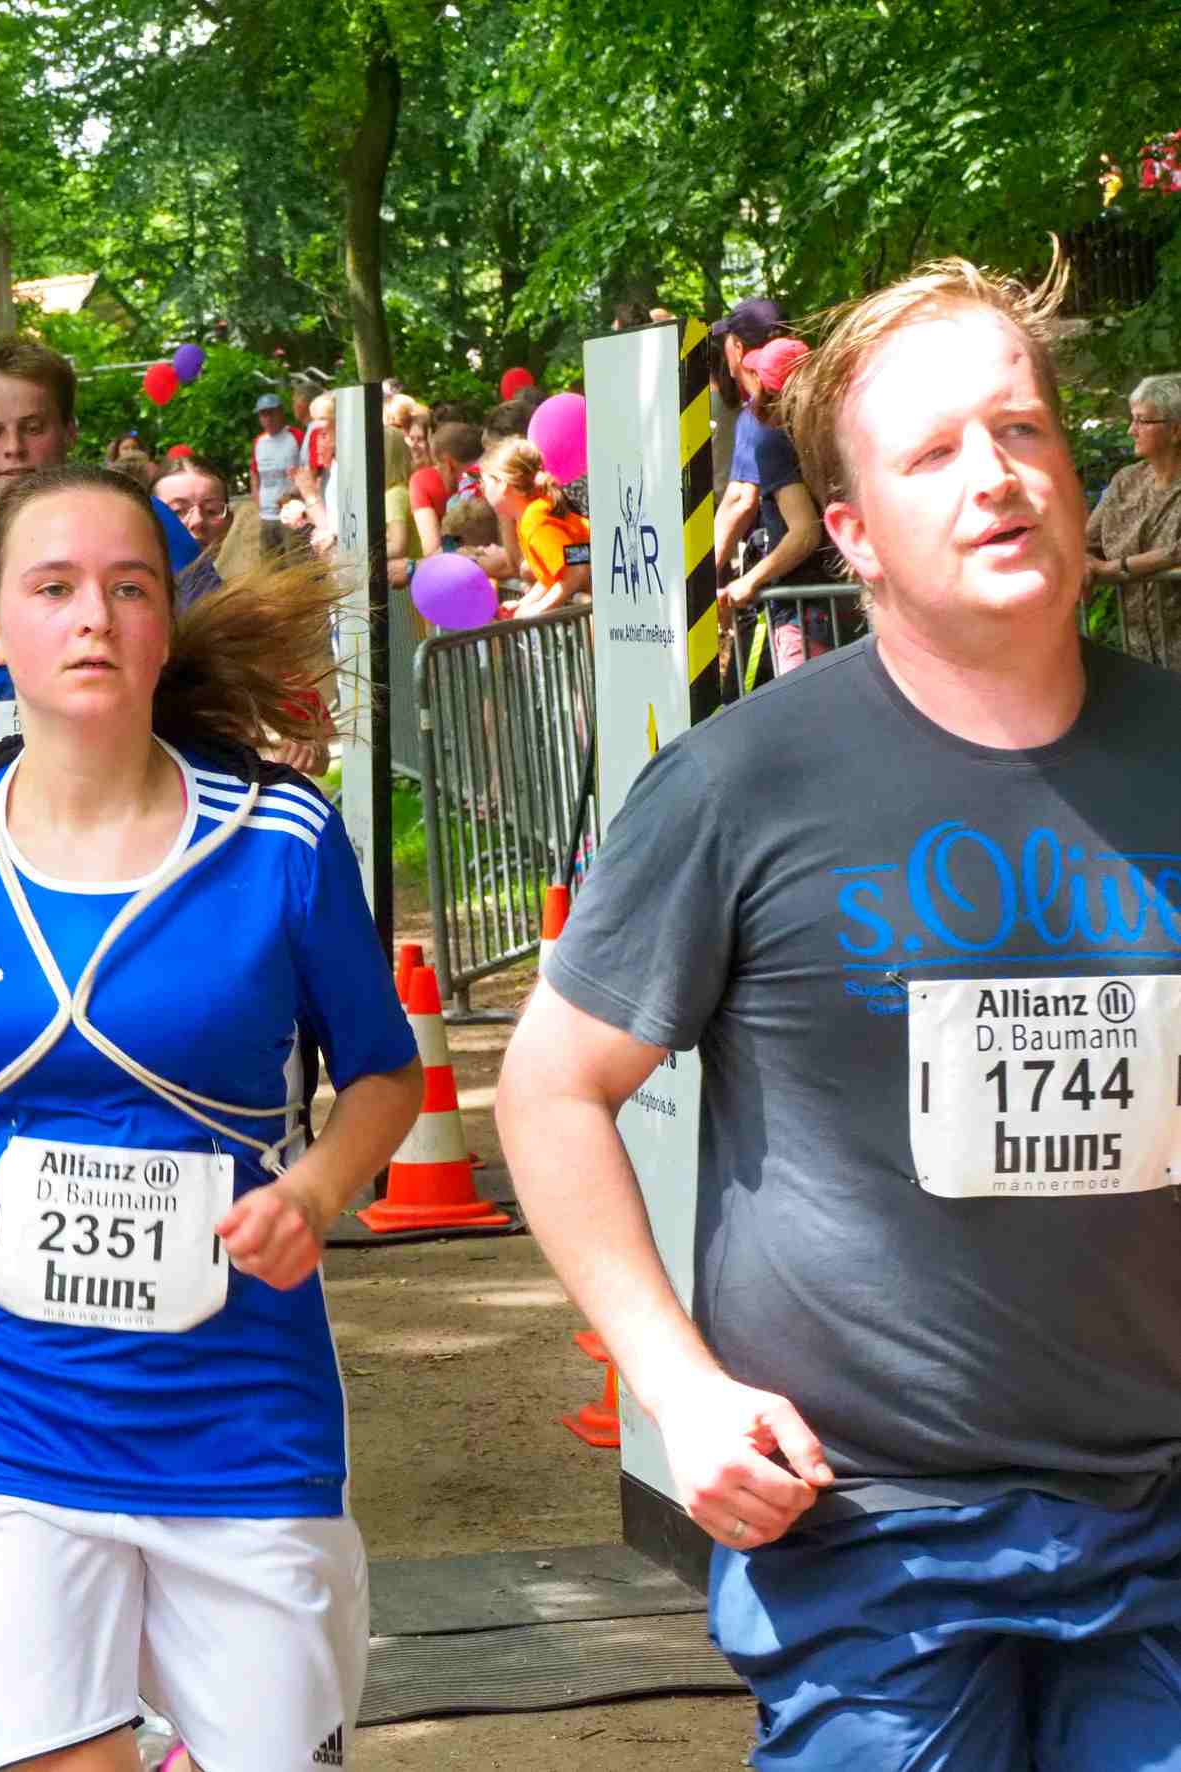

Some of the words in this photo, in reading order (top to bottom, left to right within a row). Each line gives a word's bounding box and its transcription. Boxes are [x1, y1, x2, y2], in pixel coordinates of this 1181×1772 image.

[976, 989, 1089, 1018] Allianz
[976, 1025, 1003, 1051] D.
[1012, 1024, 1137, 1051] Baumann
[984, 1057, 1134, 1113] 1744
[39, 1151, 136, 1182] Allianz
[995, 1121, 1122, 1173] bruns
[37, 1178, 59, 1203] D.
[66, 1182, 177, 1212] Baumann
[37, 1210, 164, 1262] 2351
[44, 1260, 157, 1311] bruns
